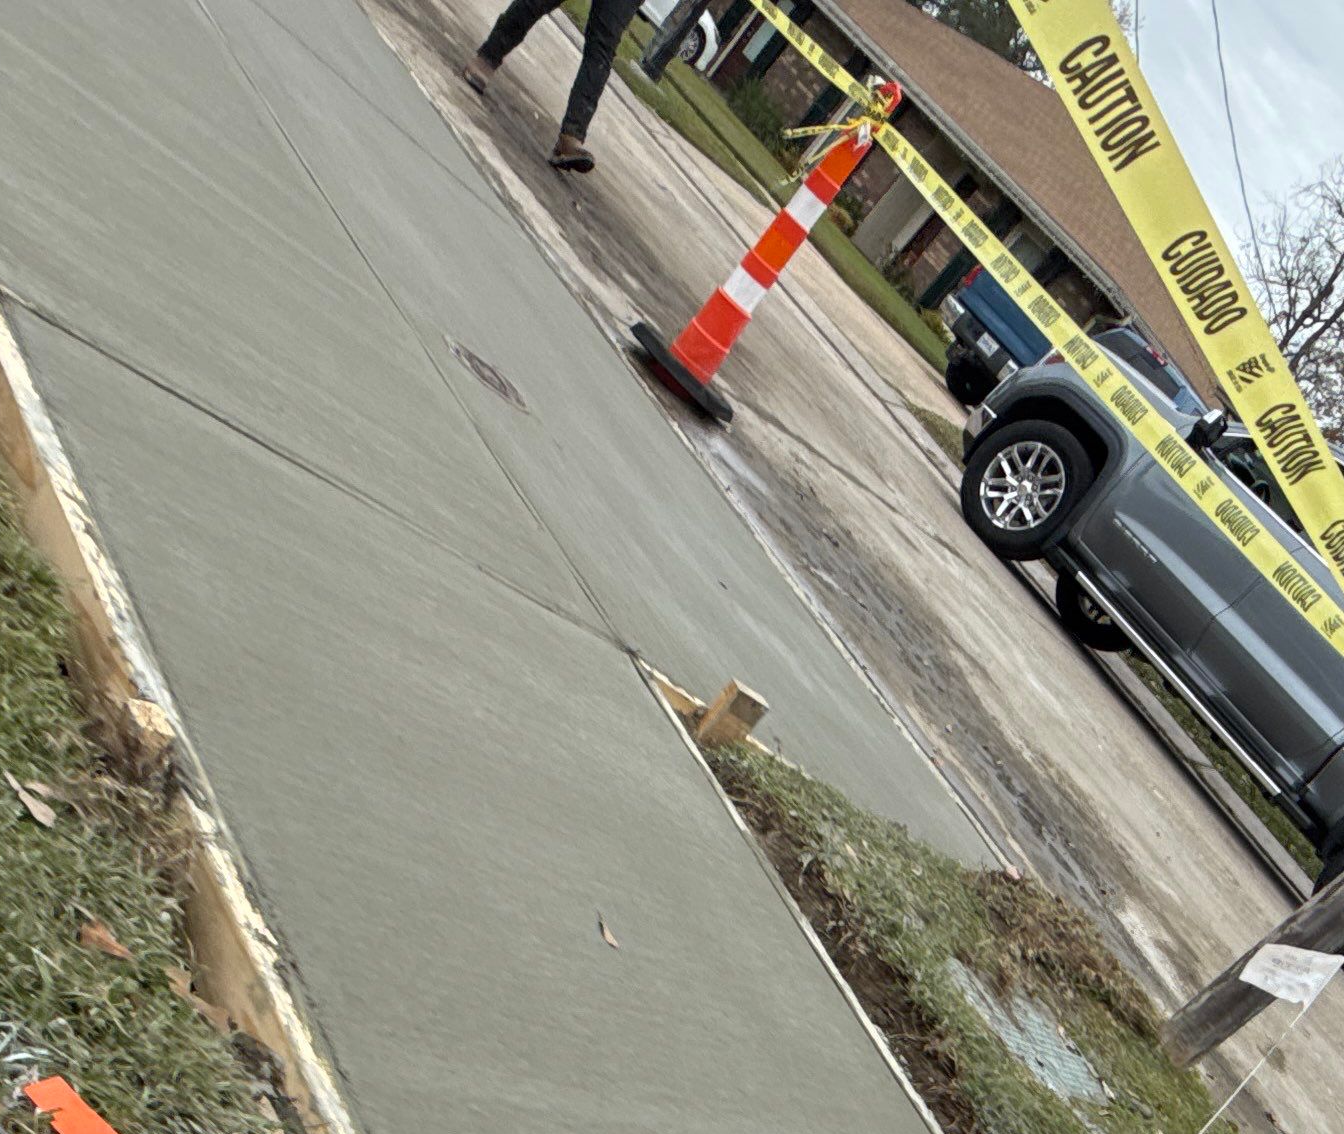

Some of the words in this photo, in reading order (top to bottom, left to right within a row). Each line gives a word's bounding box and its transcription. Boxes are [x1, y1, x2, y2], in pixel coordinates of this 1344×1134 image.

[1059, 34, 1161, 172] CAUTION
[1161, 230, 1248, 336] CUIDADO
[1256, 403, 1327, 486] CAUTION
